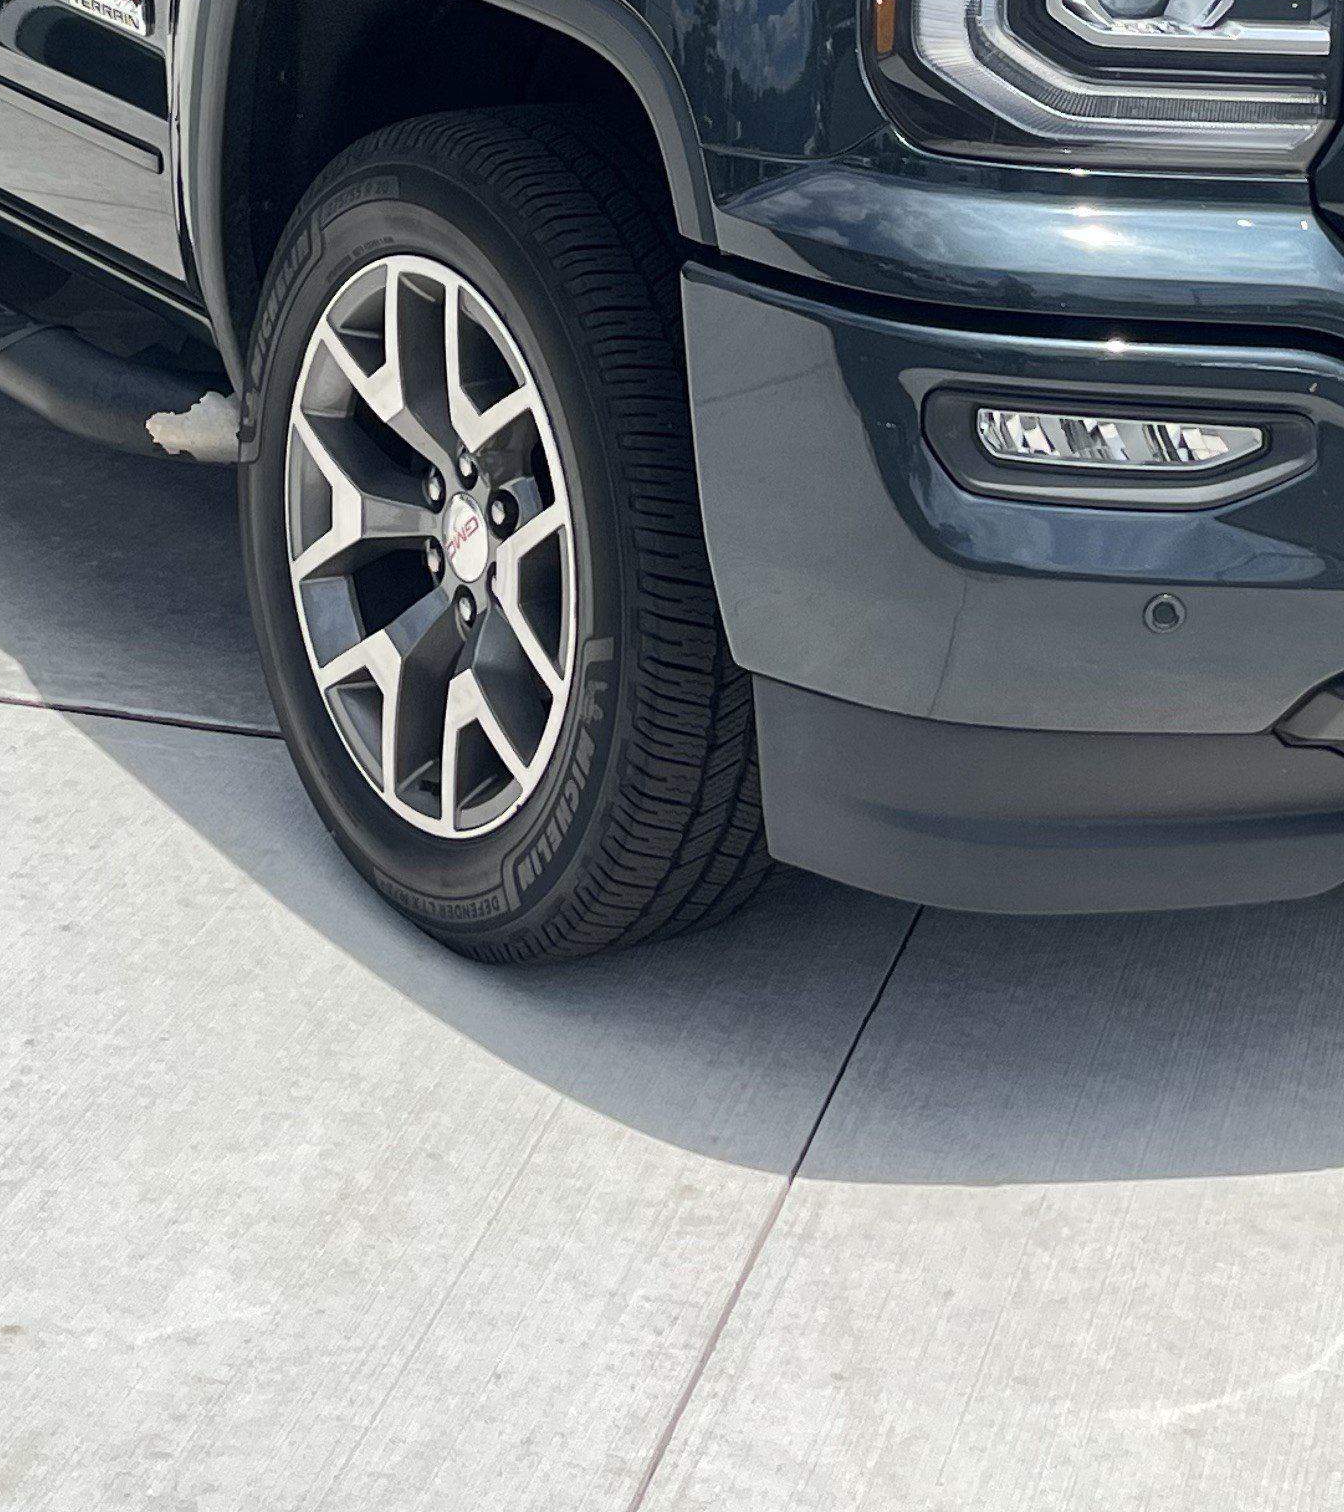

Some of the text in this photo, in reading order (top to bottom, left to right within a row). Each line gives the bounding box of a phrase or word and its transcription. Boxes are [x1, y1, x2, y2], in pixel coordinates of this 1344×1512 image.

[250, 227, 310, 388] MICHELIN
[445, 515, 479, 560] GMC
[517, 725, 596, 891] MICHELIN
[438, 894, 501, 920] DEFENDER
